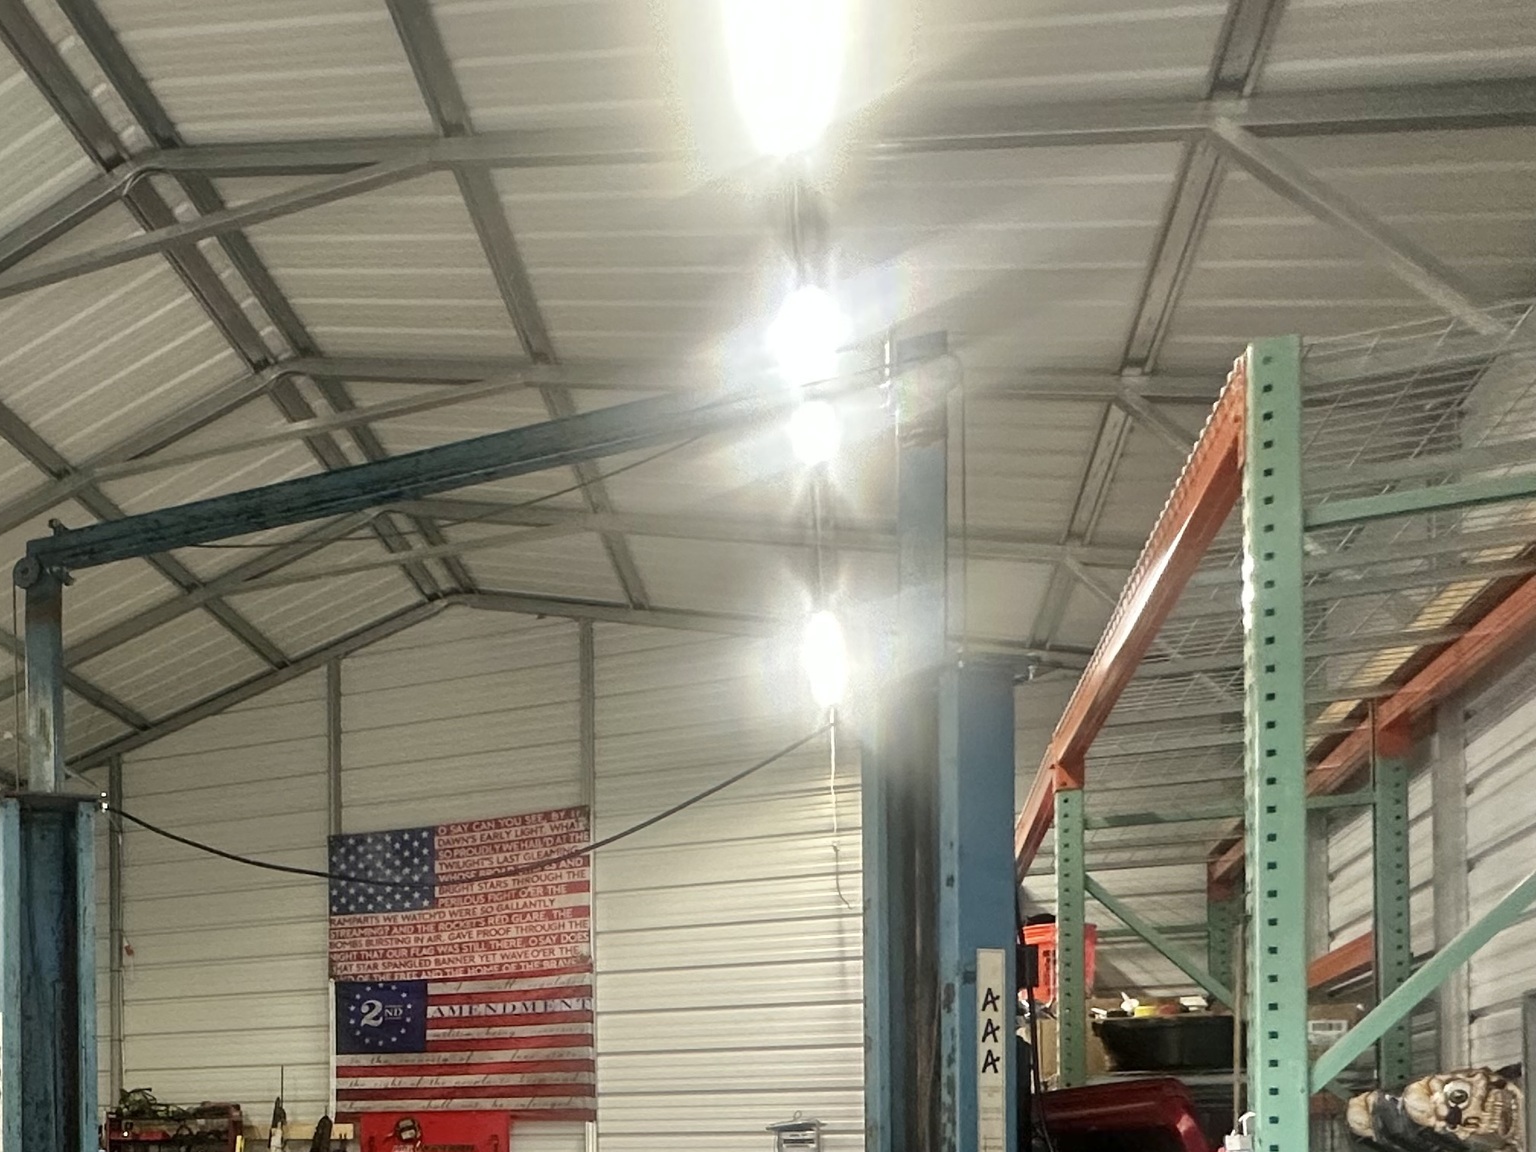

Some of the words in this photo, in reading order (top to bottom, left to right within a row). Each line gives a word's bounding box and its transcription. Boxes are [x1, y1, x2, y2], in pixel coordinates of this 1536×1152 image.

[438, 826, 447, 836] O
[450, 823, 469, 834] SAY
[473, 820, 495, 831] CAN
[498, 816, 522, 828] YOU
[552, 811, 565, 821] BY
[480, 829, 512, 842] EARLY
[438, 847, 452, 859] SO
[453, 843, 501, 857] PROUDLY
[502, 841, 520, 852] WE
[555, 834, 568, 845] AT
[569, 831, 589, 842] THE
[497, 853, 520, 865] LAST
[559, 857, 583, 868] AND
[478, 879, 508, 891] STARS
[511, 872, 563, 886] THROUGH
[567, 869, 586, 879] THE
[438, 895, 485, 908] PERILOUS
[488, 890, 517, 902] FIGHT
[547, 884, 567, 895] THE
[330, 915, 380, 926] RAMPARTS
[384, 914, 398, 923] WE
[449, 907, 477, 918] WERE
[481, 905, 494, 914] SO
[496, 898, 555, 912] GALLANTLY
[391, 925, 414, 935] AND
[417, 923, 436, 933] THE
[488, 915, 509, 925] RED
[553, 909, 573, 919] THE
[330, 939, 363, 950] BOMBS
[365, 937, 411, 948] BURSTING
[414, 936, 424, 945] IN
[448, 930, 474, 941] GAVE
[476, 927, 512, 938] PROOF
[515, 922, 565, 935] THROUGH
[568, 920, 589, 930] THE
[360, 949, 384, 960] THAT
[387, 948, 409, 958] OUR
[410, 946, 435, 957] FLAG
[436, 943, 460, 954] WAS
[462, 941, 486, 952] STILL
[529, 937, 538, 946] O
[539, 935, 558, 945] SAY
[560, 931, 589, 943] DOES
[356, 962, 379, 973] STAR
[382, 958, 431, 970] SPANGLED
[434, 955, 475, 967] BANNER
[478, 952, 497, 963] YET
[500, 950, 529, 960] WAVE
[559, 945, 580, 956] THE
[421, 970, 443, 979] AND
[445, 967, 465, 977] THE
[467, 964, 500, 976] HOME
[502, 963, 518, 972] OF
[519, 961, 542, 971] THE
[360, 999, 383, 1028] 2
[384, 1009, 403, 1017] ND
[431, 998, 592, 1018] AMENDMENT
